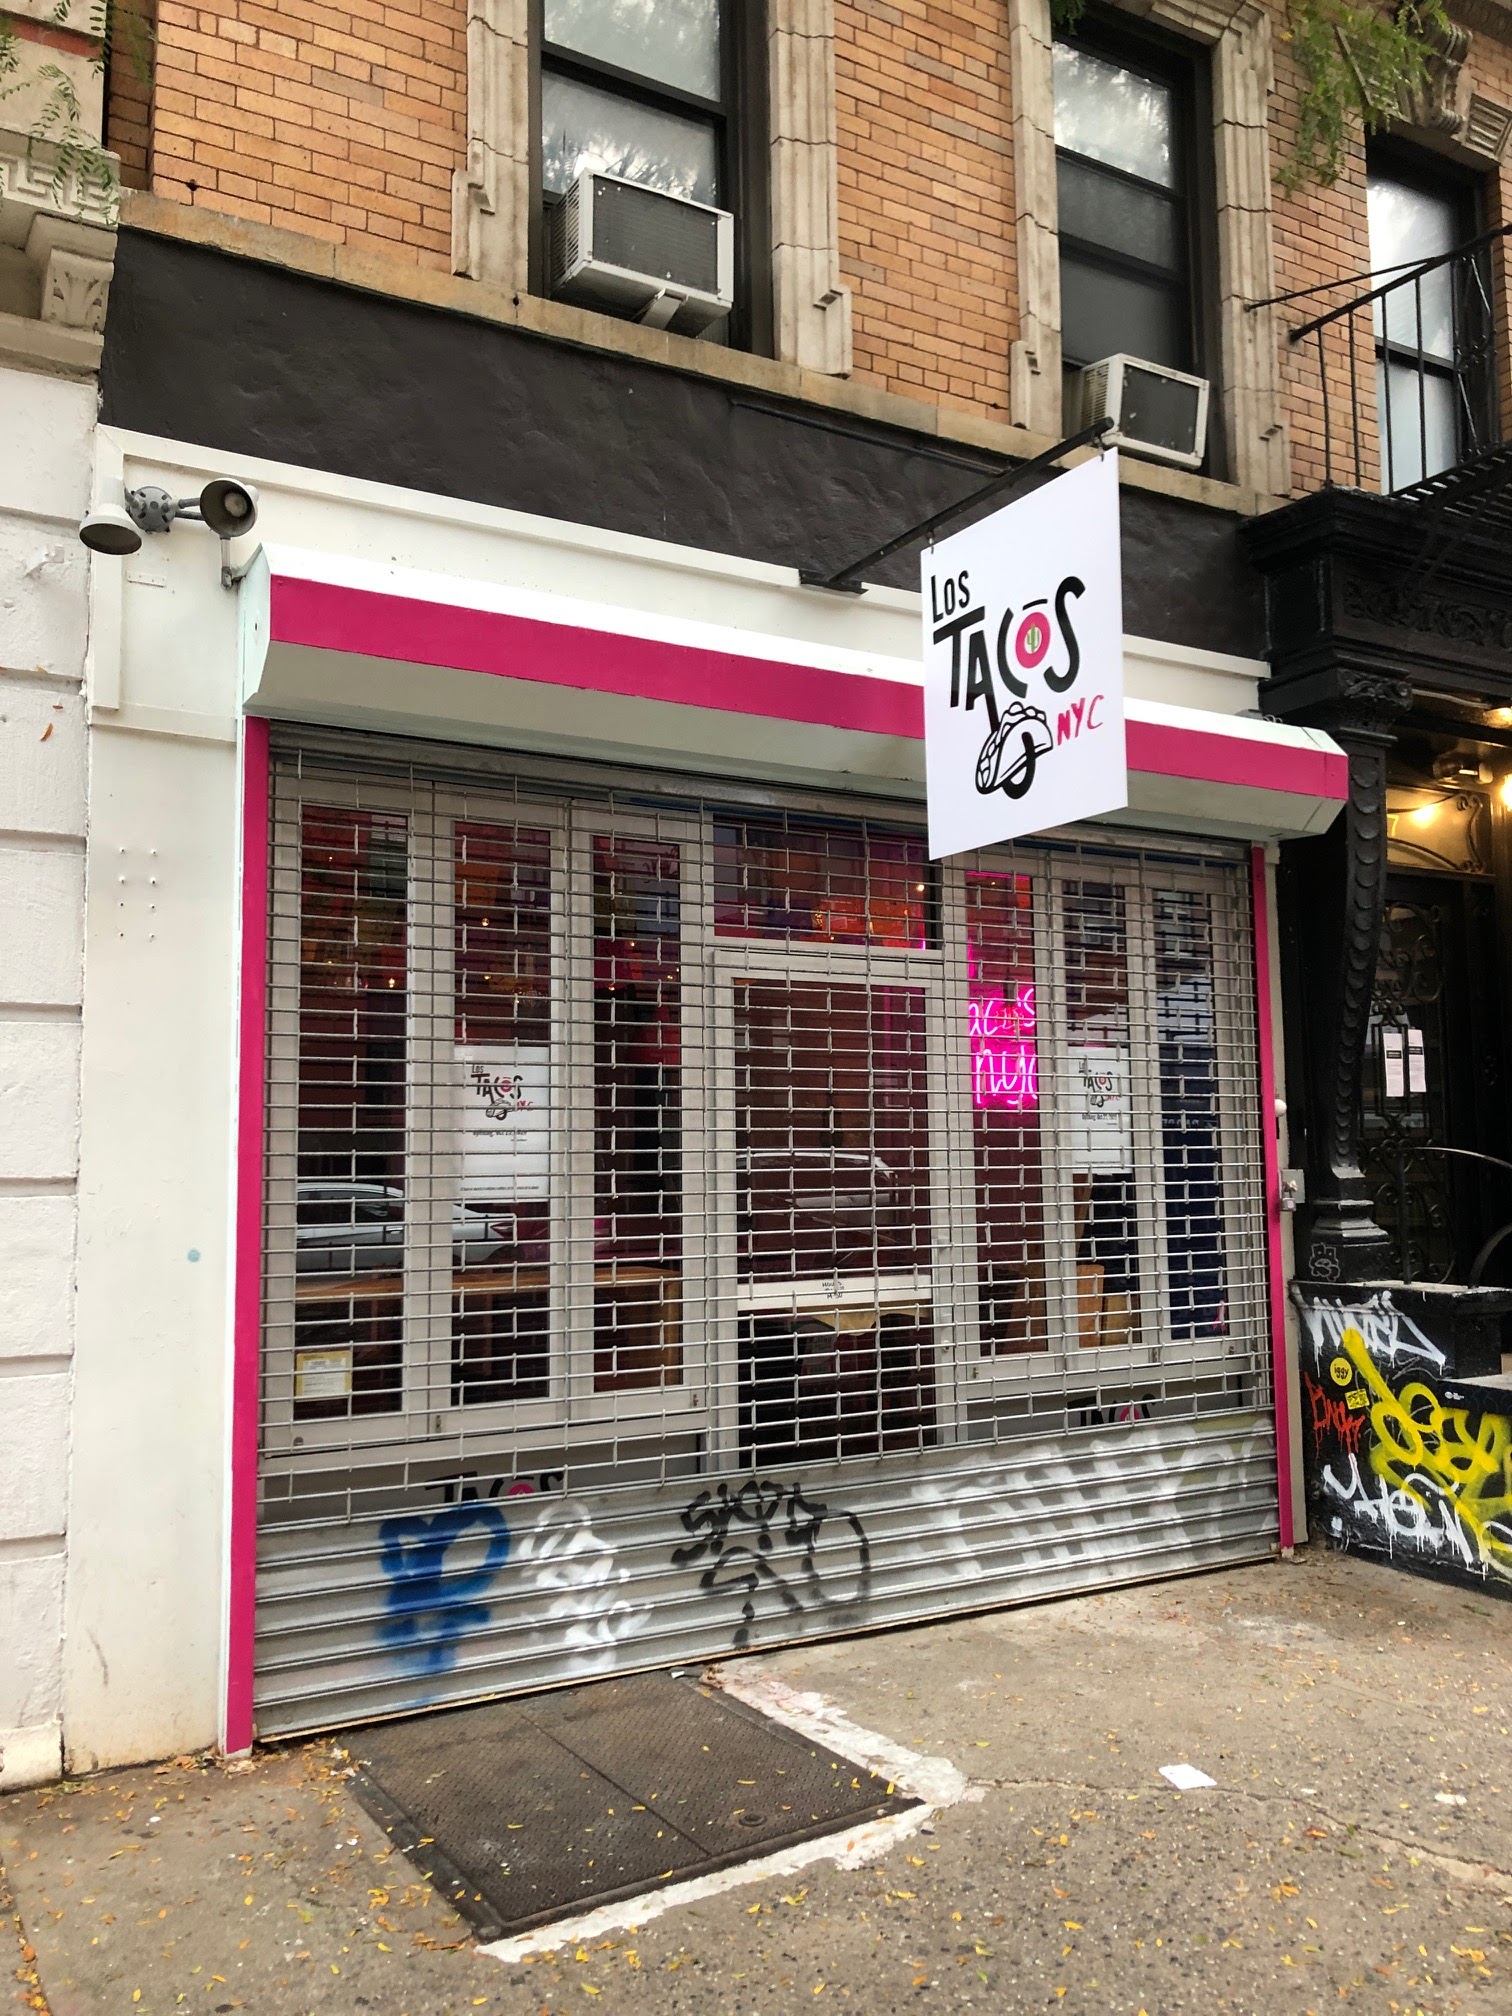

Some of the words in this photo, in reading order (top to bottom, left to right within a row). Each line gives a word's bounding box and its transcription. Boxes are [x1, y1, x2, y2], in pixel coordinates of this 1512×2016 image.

[931, 569, 971, 624] LOS
[932, 575, 1086, 734] TACOS
[1055, 694, 1105, 747] NYC
[1333, 1363, 1350, 1380] iggy
